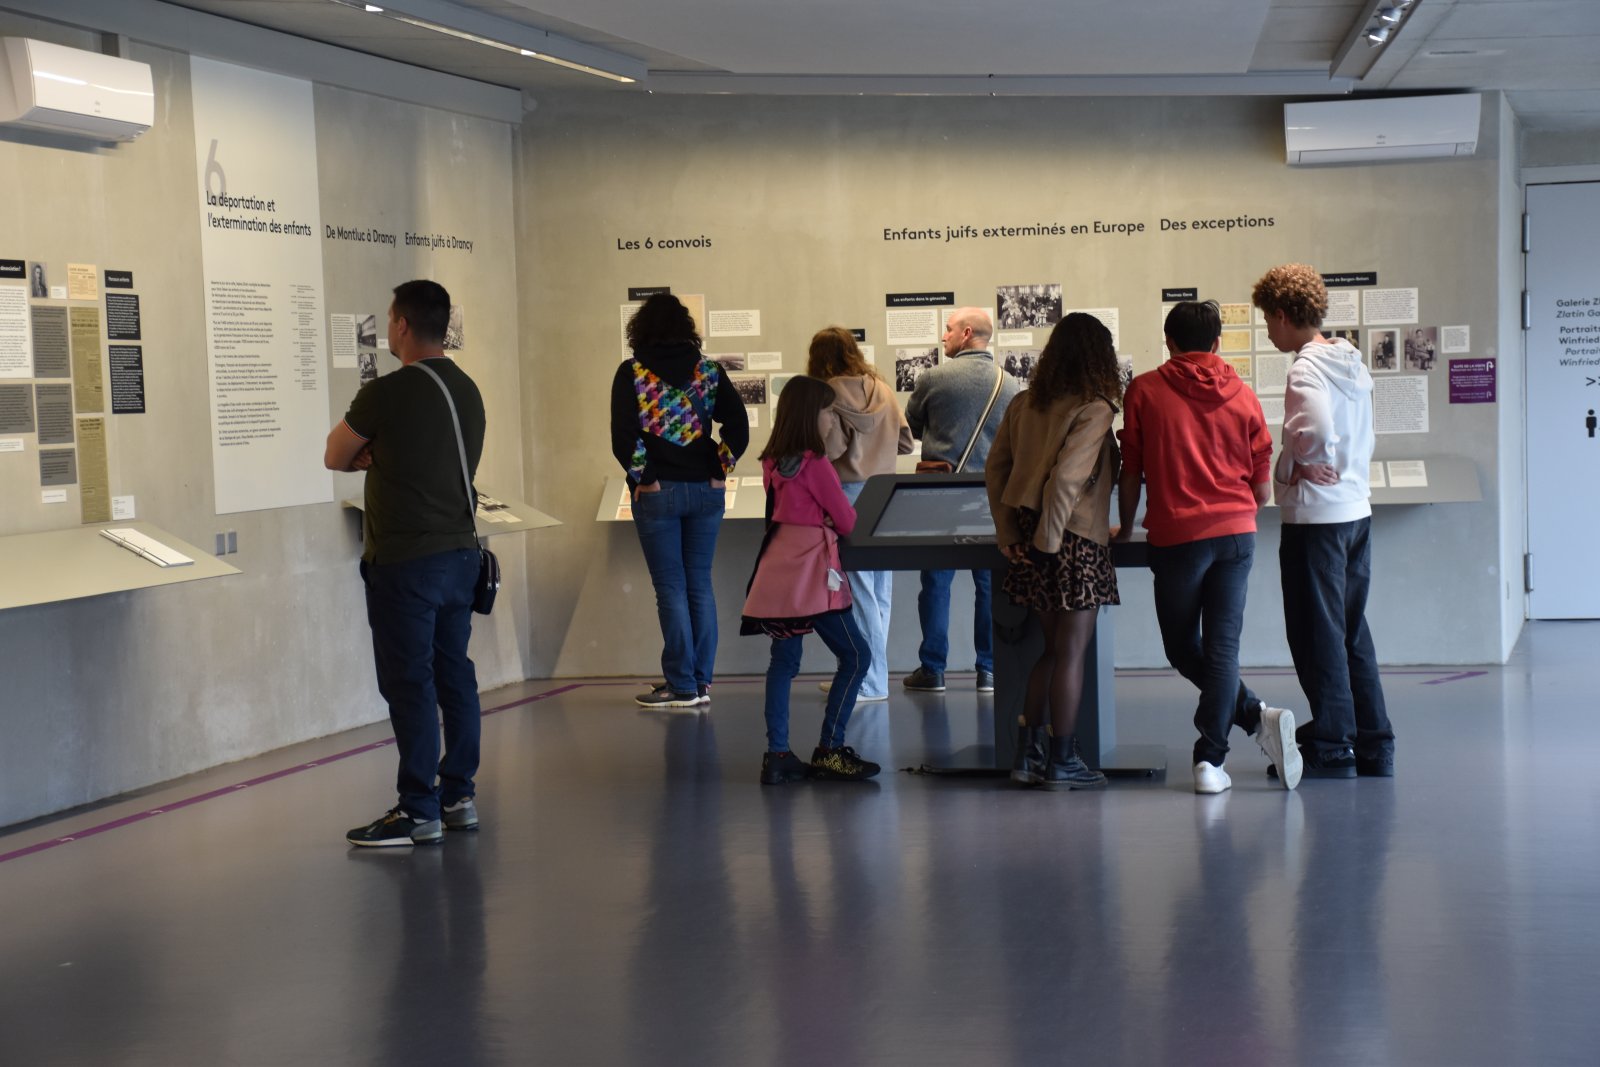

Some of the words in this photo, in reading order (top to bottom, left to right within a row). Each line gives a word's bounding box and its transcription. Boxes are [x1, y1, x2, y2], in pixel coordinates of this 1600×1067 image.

[204, 138, 227, 207] 6
[206, 190, 217, 206] La
[218, 191, 266, 212] déportation
[267, 199, 276, 212] et
[207, 212, 268, 232] l'extermination
[269, 218, 281, 234] des
[283, 220, 312, 237] enfants
[883, 227, 942, 241] Enfants
[945, 224, 978, 243] juifs
[982, 222, 1066, 238] exterminés
[1070, 224, 1088, 234] en
[1093, 220, 1145, 236] Europe
[1160, 218, 1187, 231] Des
[1191, 214, 1275, 232] exceptions
[325, 224, 336, 239] De
[337, 226, 366, 242] Montluc
[367, 229, 372, 242] à
[373, 229, 397, 248] Drancy
[405, 232, 430, 247] Enfants
[431, 234, 446, 251] juifs
[446, 236, 451, 248] à
[452, 236, 474, 253] Drancy
[617, 238, 640, 250] Les
[644, 237, 654, 249] 6
[658, 235, 712, 249] convois
[1556, 298, 1591, 308] Galerie
[1556, 310, 1585, 318] Zlatin
[1559, 336, 1600, 344] Winfried
